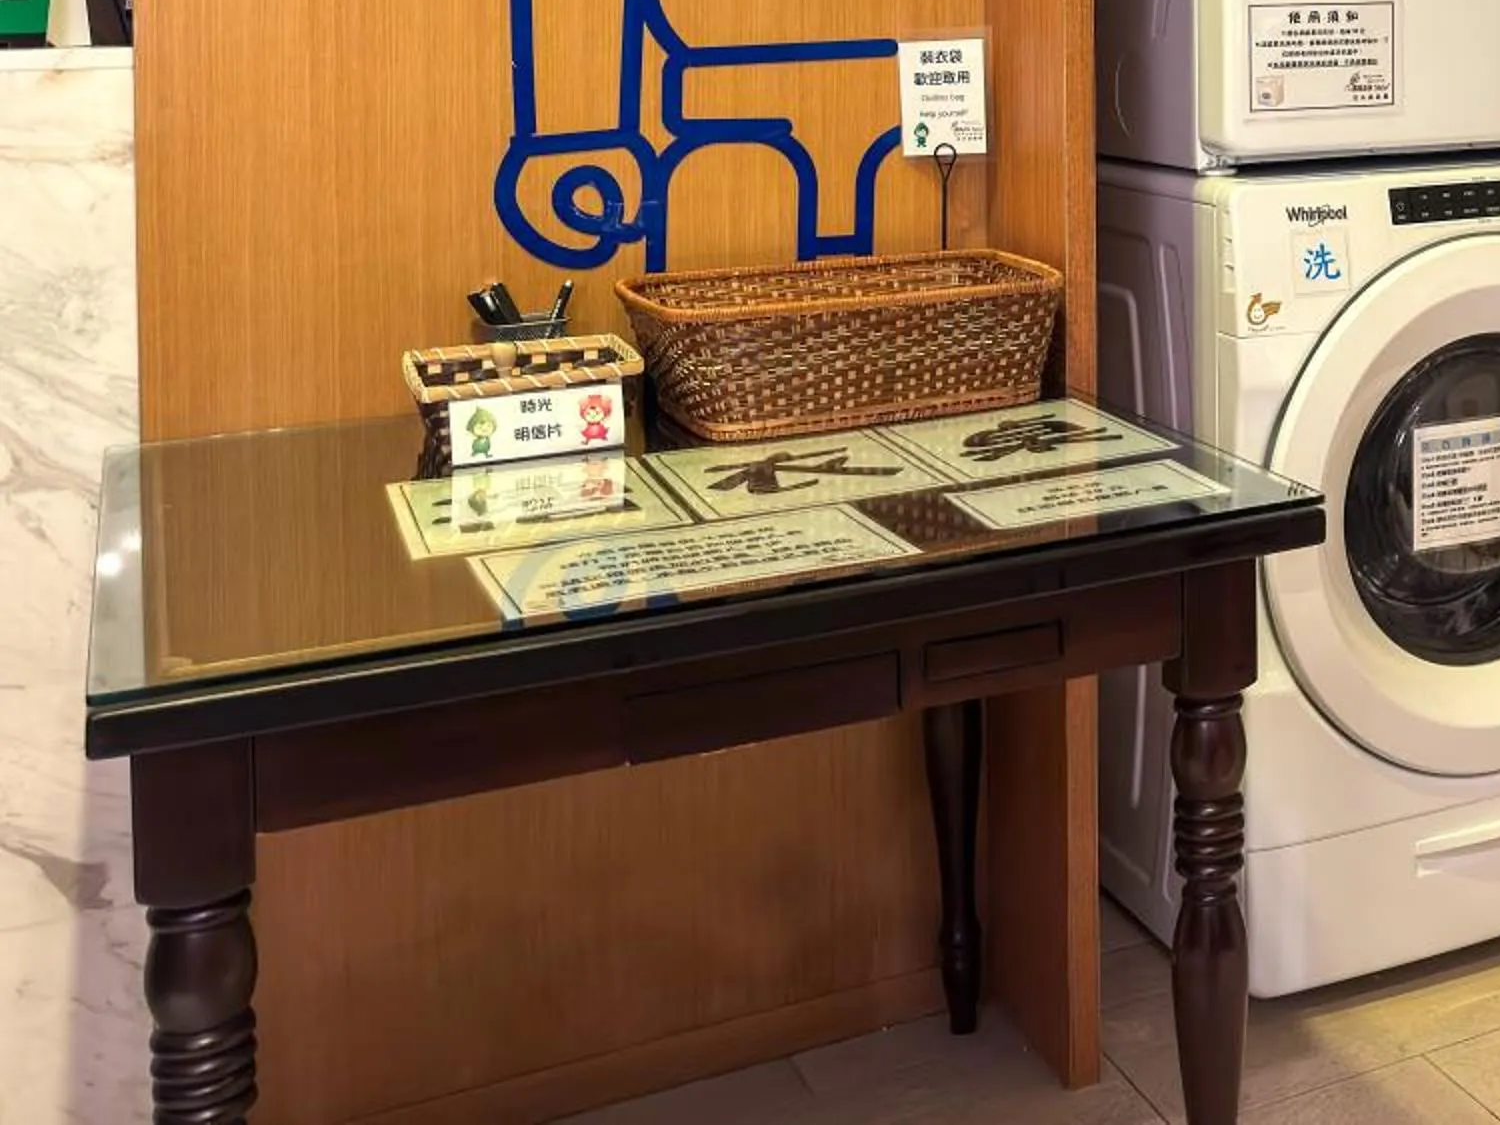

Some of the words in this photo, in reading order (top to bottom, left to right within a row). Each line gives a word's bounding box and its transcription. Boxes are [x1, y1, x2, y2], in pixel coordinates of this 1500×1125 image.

[1285, 204, 1348, 227] Whirlpool
[1303, 242, 1341, 280] 洗
[519, 397, 553, 414] 時光
[513, 424, 563, 443] 明信片
